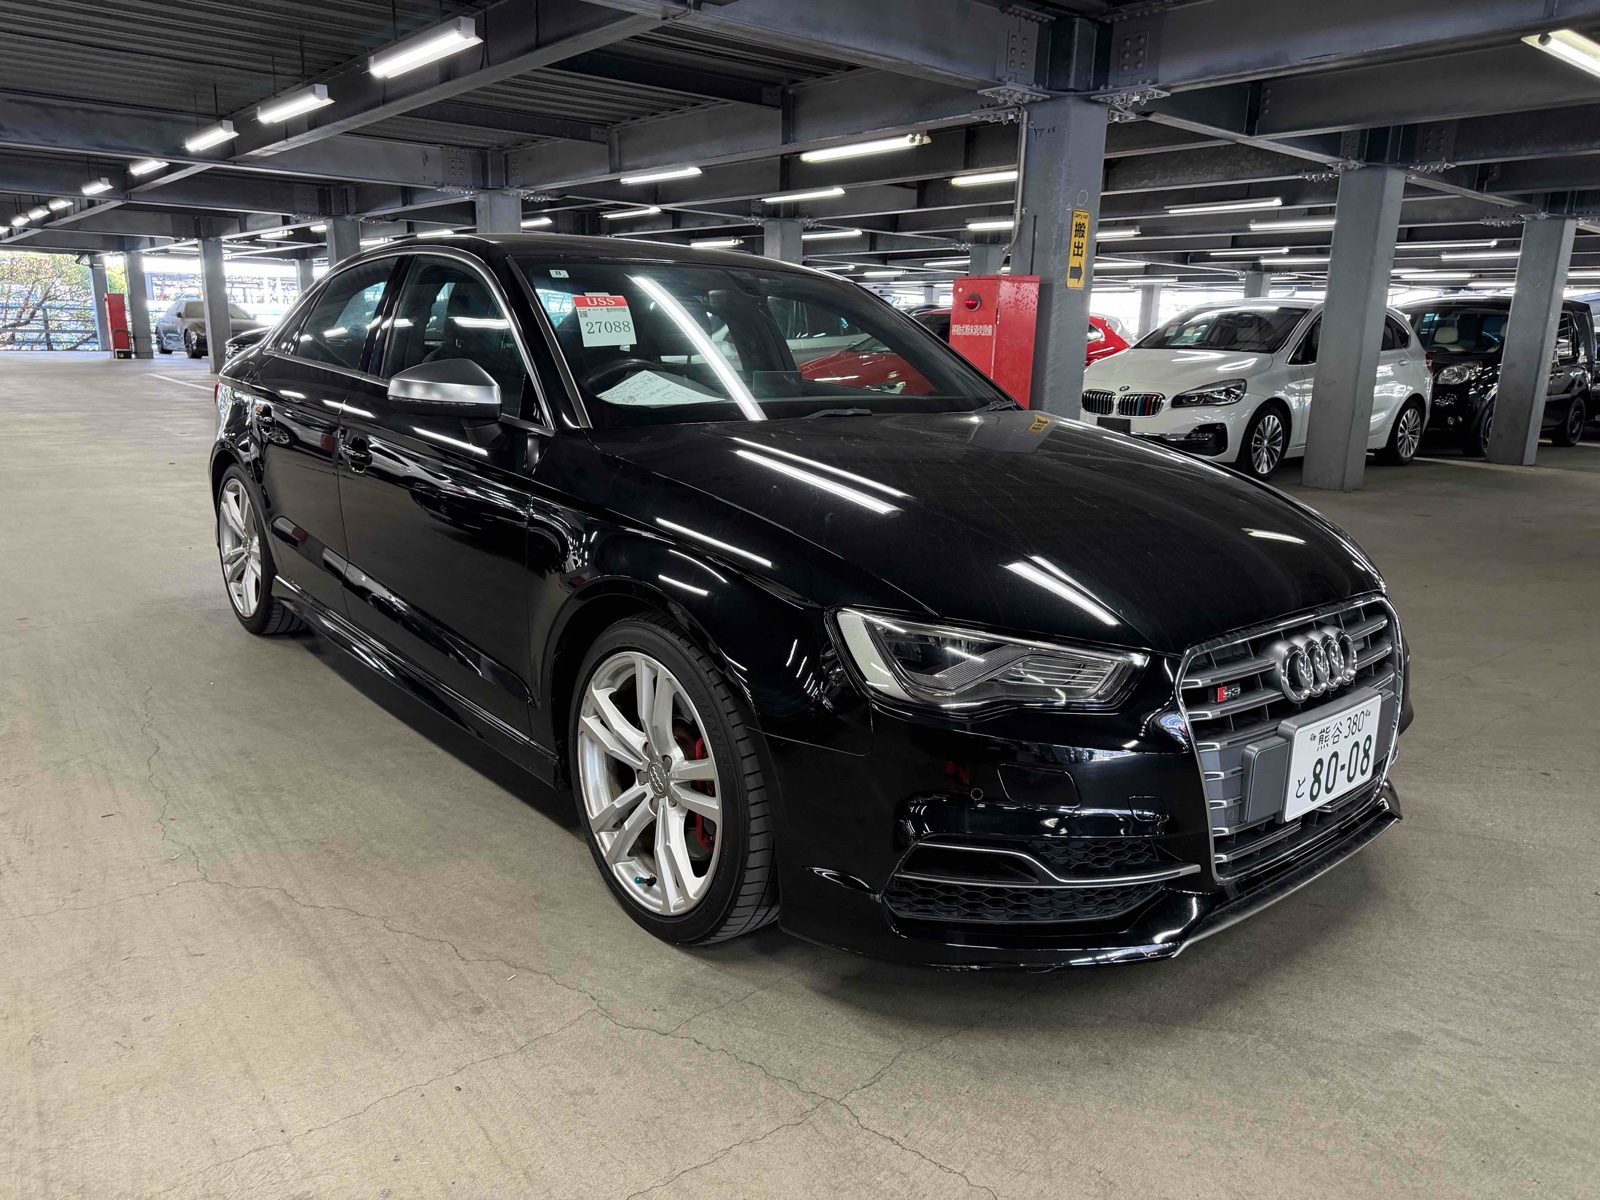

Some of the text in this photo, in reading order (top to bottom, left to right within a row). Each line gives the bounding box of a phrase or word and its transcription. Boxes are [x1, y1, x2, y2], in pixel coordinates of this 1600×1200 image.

[1073, 212, 1083, 220] Carry
[1072, 221, 1086, 258] 搬出
[585, 297, 616, 306] USS
[586, 320, 631, 335] 27088
[1316, 710, 1365, 752] 熊谷 380
[1295, 734, 1372, 802] と 80-08
